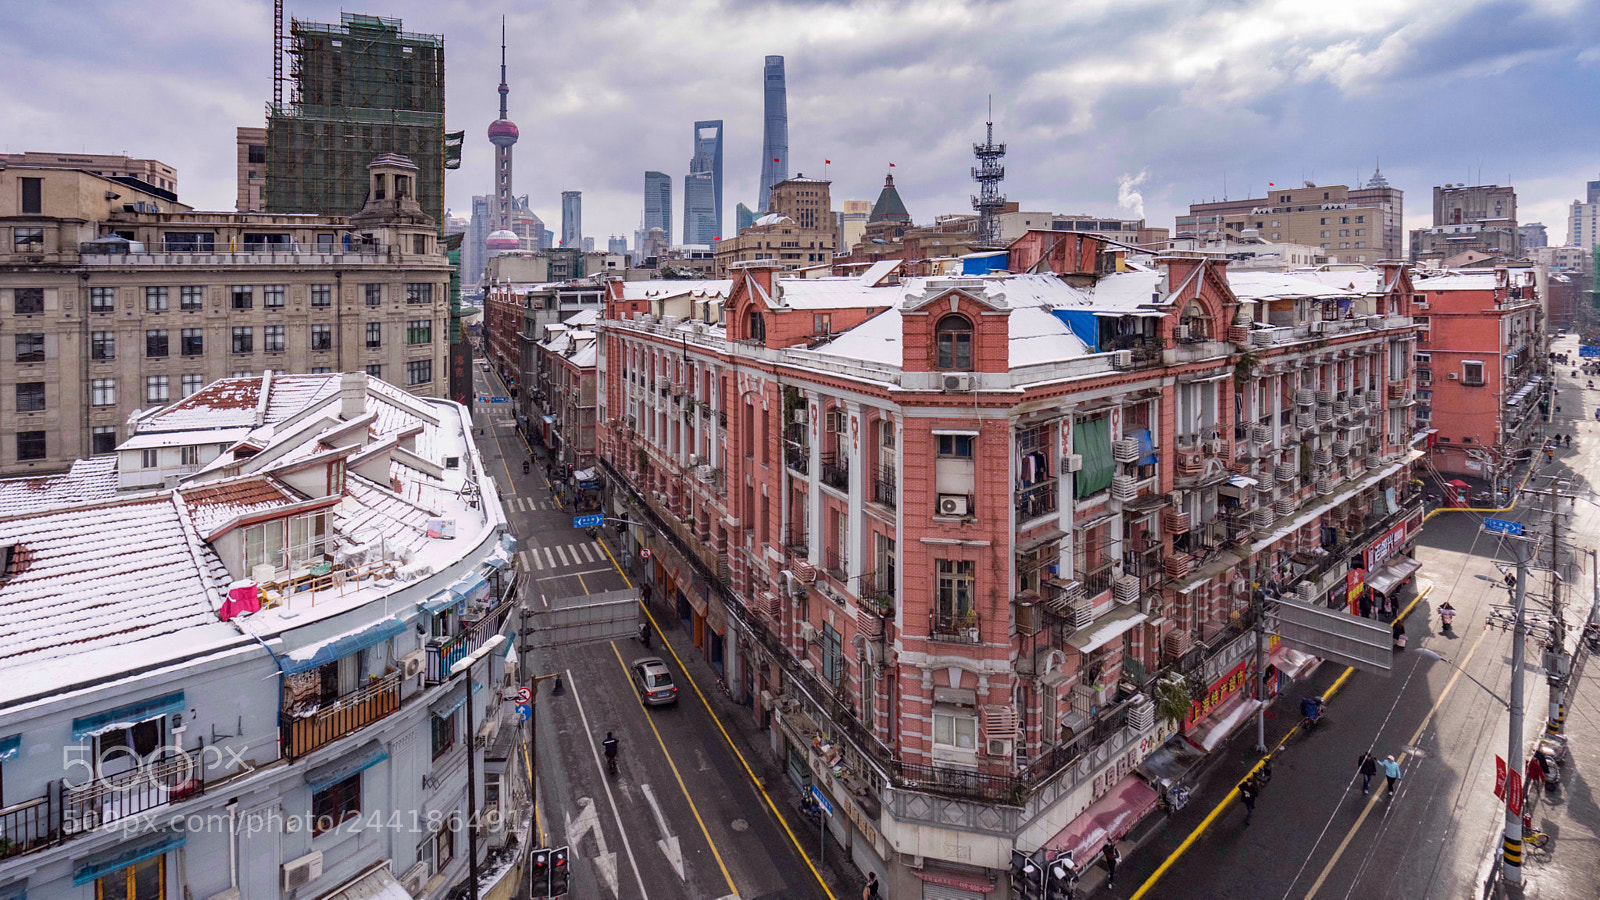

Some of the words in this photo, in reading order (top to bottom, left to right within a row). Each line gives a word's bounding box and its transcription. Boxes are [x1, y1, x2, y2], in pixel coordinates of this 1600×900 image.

[1191, 668, 1244, 724] 上海特产超市
